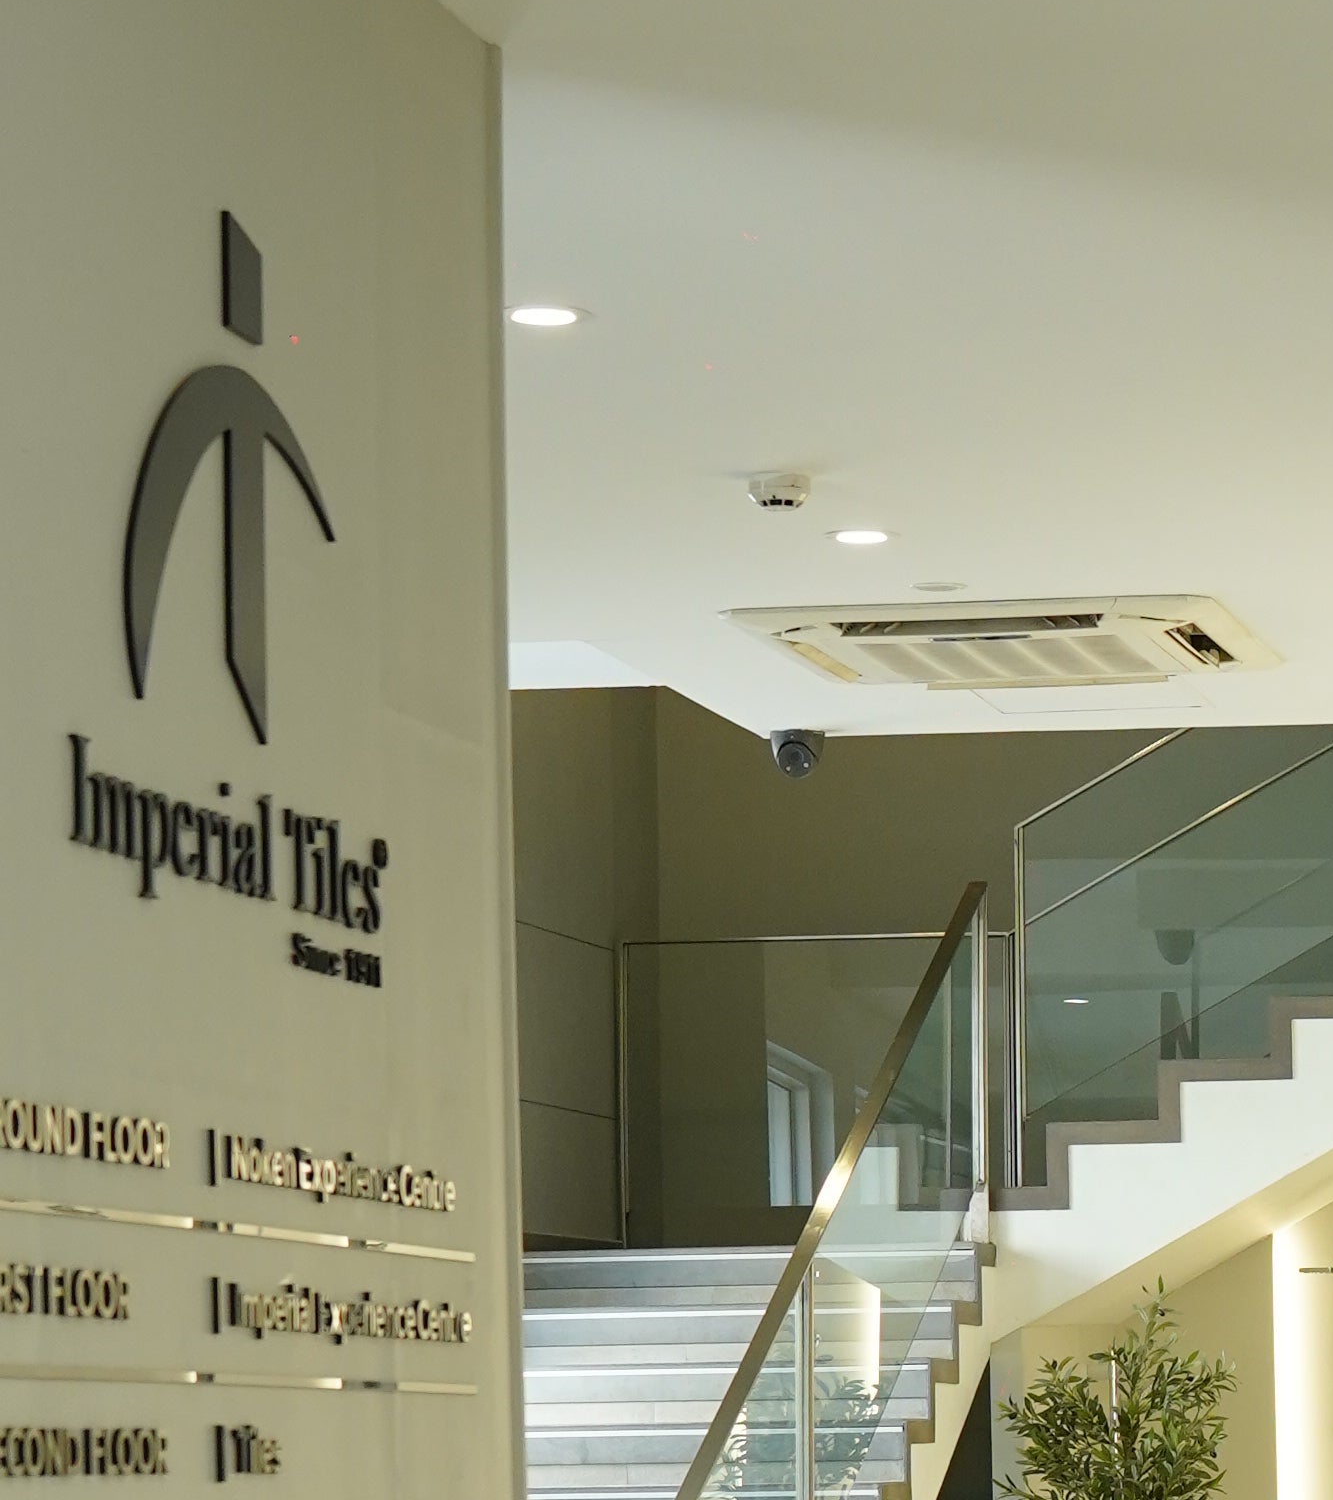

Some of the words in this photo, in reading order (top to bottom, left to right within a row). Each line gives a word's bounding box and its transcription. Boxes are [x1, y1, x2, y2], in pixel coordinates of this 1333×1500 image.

[67, 733, 277, 900] Imperial
[290, 932, 341, 976] Since
[82, 1112, 170, 1169] FLOOR
[224, 1134, 298, 1190] Noken
[294, 1146, 403, 1206] Experience
[397, 1164, 457, 1213] Centre
[44, 1267, 130, 1320] FLOOR
[228, 1277, 316, 1340] Imperial
[315, 1290, 417, 1345] Experience
[413, 1299, 473, 1344] Centre
[82, 1427, 168, 1476] FLOOR
[230, 1424, 281, 1475] Tiles
